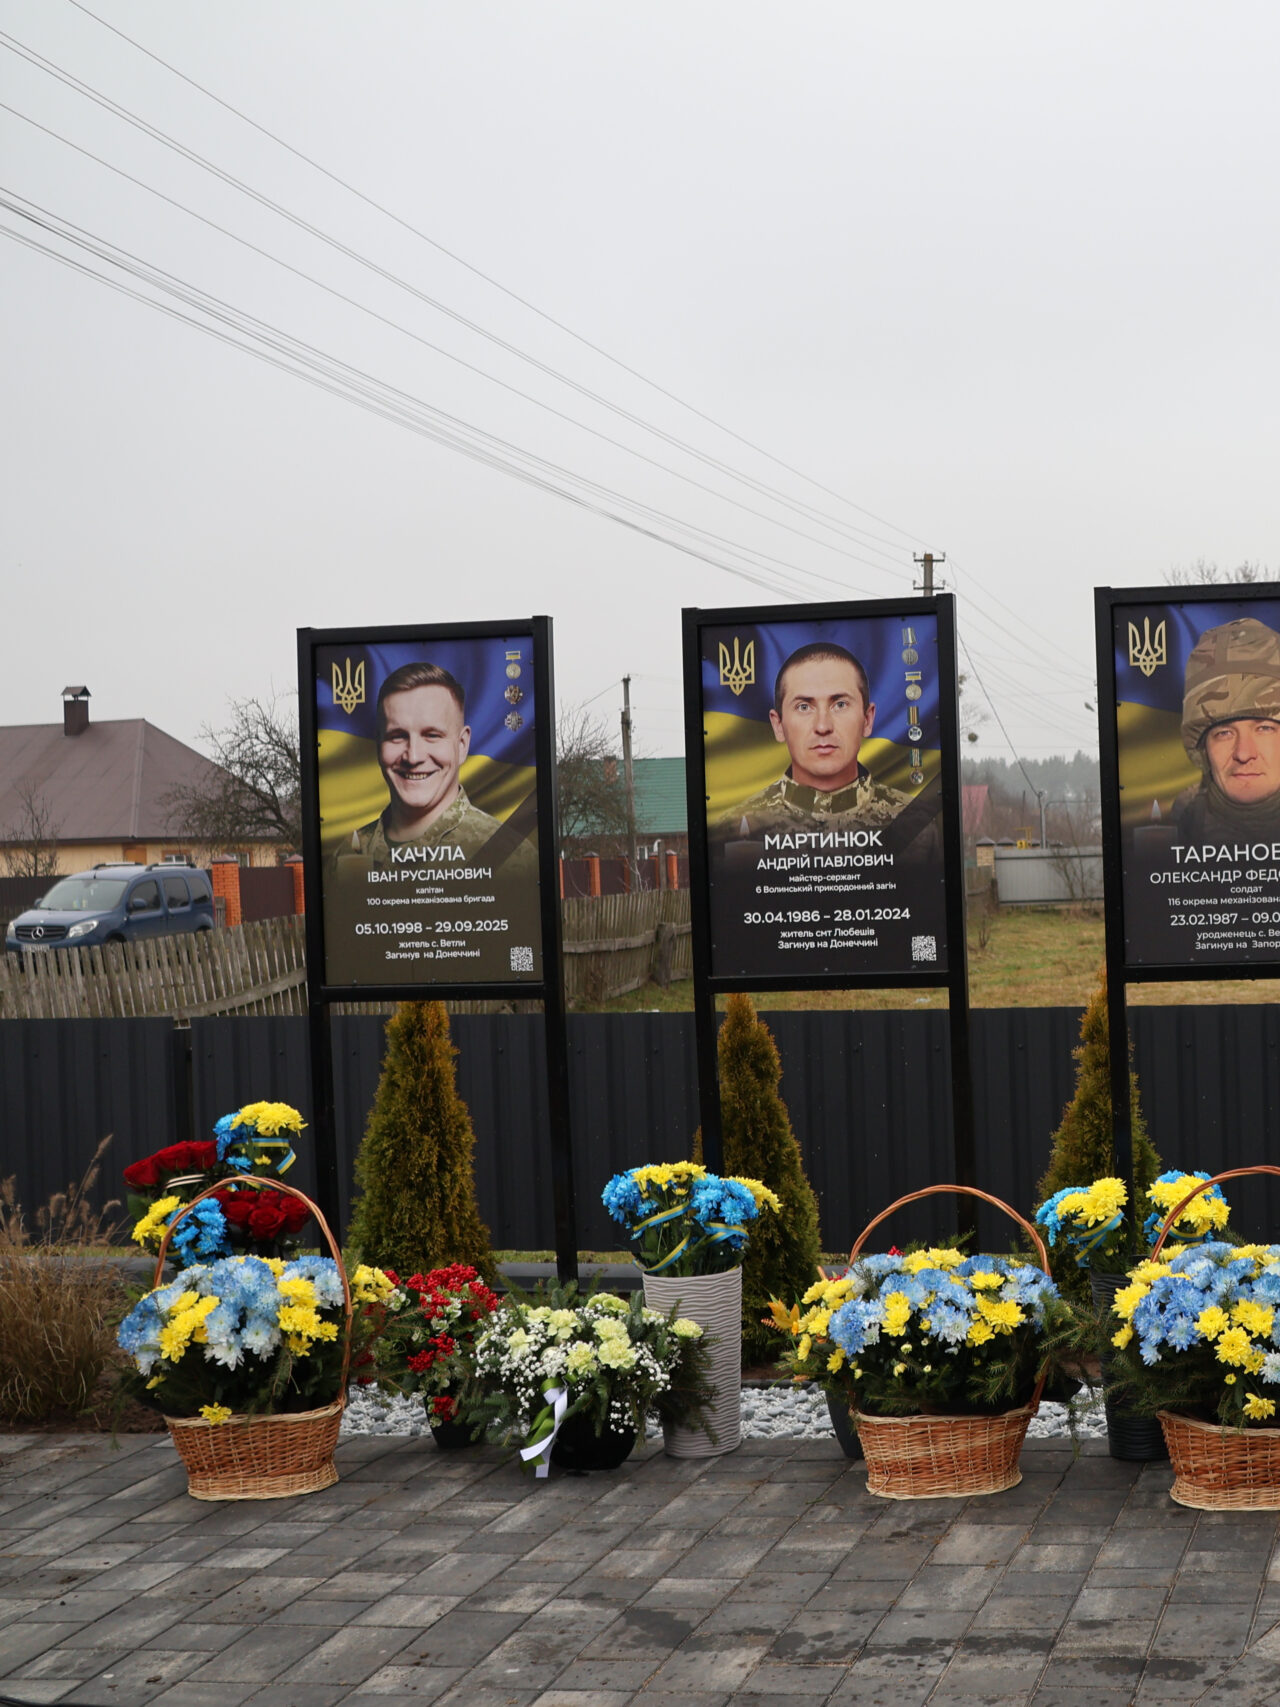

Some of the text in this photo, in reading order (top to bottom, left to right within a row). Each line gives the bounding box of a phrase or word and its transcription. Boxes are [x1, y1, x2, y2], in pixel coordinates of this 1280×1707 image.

[764, 830, 883, 850] МАРТИНЮК
[391, 846, 466, 863] КАЧУЛА
[757, 854, 894, 871] АНДРІЙ ПАВЛОВИЧ
[368, 868, 492, 882] ІВАН РУСЛАНОВИЧ
[789, 873, 861, 883] майстер-сержант
[1150, 871, 1242, 884] ОЛЕКСАНДР
[416, 886, 444, 894] капітан
[756, 881, 896, 893] 6 Волинський прикордонний загін
[1230, 885, 1263, 894] солдат
[382, 898, 410, 906] окрема
[412, 896, 462, 905] механізована
[464, 894, 495, 904] бригада
[1168, 897, 1181, 906] 116
[1183, 897, 1218, 906] окрема
[744, 910, 820, 924] 30.04.1986
[834, 908, 910, 921] 28.01.2024
[1170, 913, 1238, 926] 23.02.1987
[355, 922, 422, 935] 05.10.1998
[435, 919, 508, 933] 29.09.2025
[780, 927, 875, 938] житель смт Любешів
[1197, 931, 1256, 940] уродженець
[399, 940, 429, 948] житель
[441, 939, 466, 947] Ветли
[778, 938, 878, 950] Загинув на Донеччині
[1195, 941, 1233, 950] Загинув
[386, 952, 420, 960] Загинув
[436, 949, 480, 959] Донеччині
